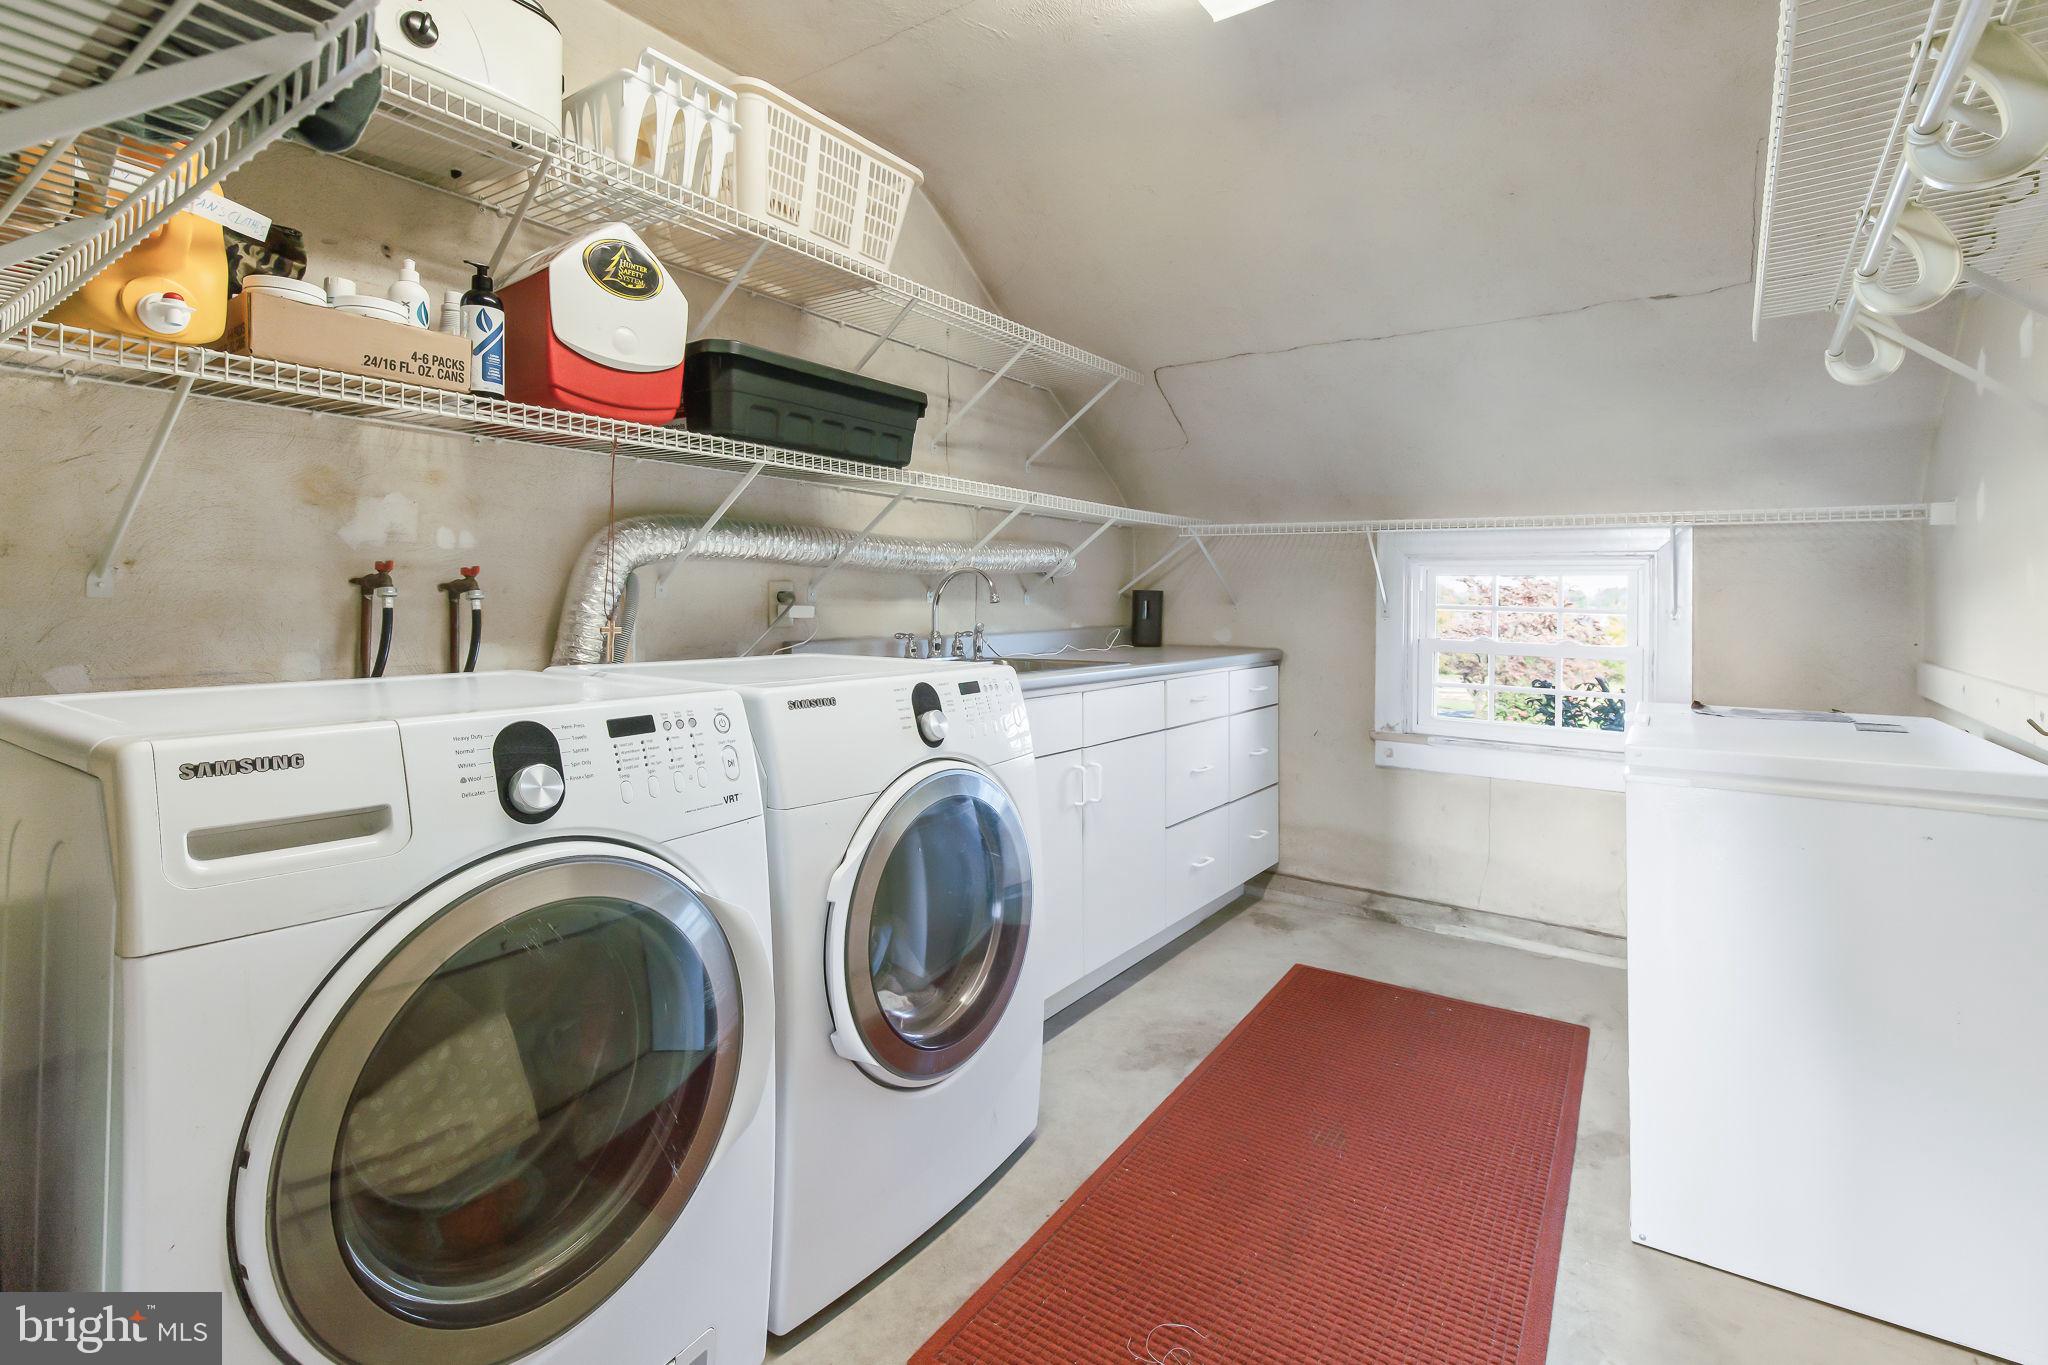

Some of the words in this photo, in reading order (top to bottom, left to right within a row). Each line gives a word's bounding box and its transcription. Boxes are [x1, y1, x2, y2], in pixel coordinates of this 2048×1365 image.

[618, 265, 645, 279] SAFETY
[619, 258, 648, 273] HUNTER
[617, 271, 645, 286] SYSTEM
[363, 354, 396, 371] 24/16
[399, 360, 415, 374] FL.
[418, 364, 434, 378] OZ.
[437, 368, 465, 383] CANS
[411, 351, 429, 365] 4-6
[432, 355, 465, 371] PACKS
[787, 696, 837, 711] SAMSUNG
[179, 753, 305, 780] SAMSUNG
[461, 791, 486, 799] Delicates
[723, 794, 740, 804] VRT
